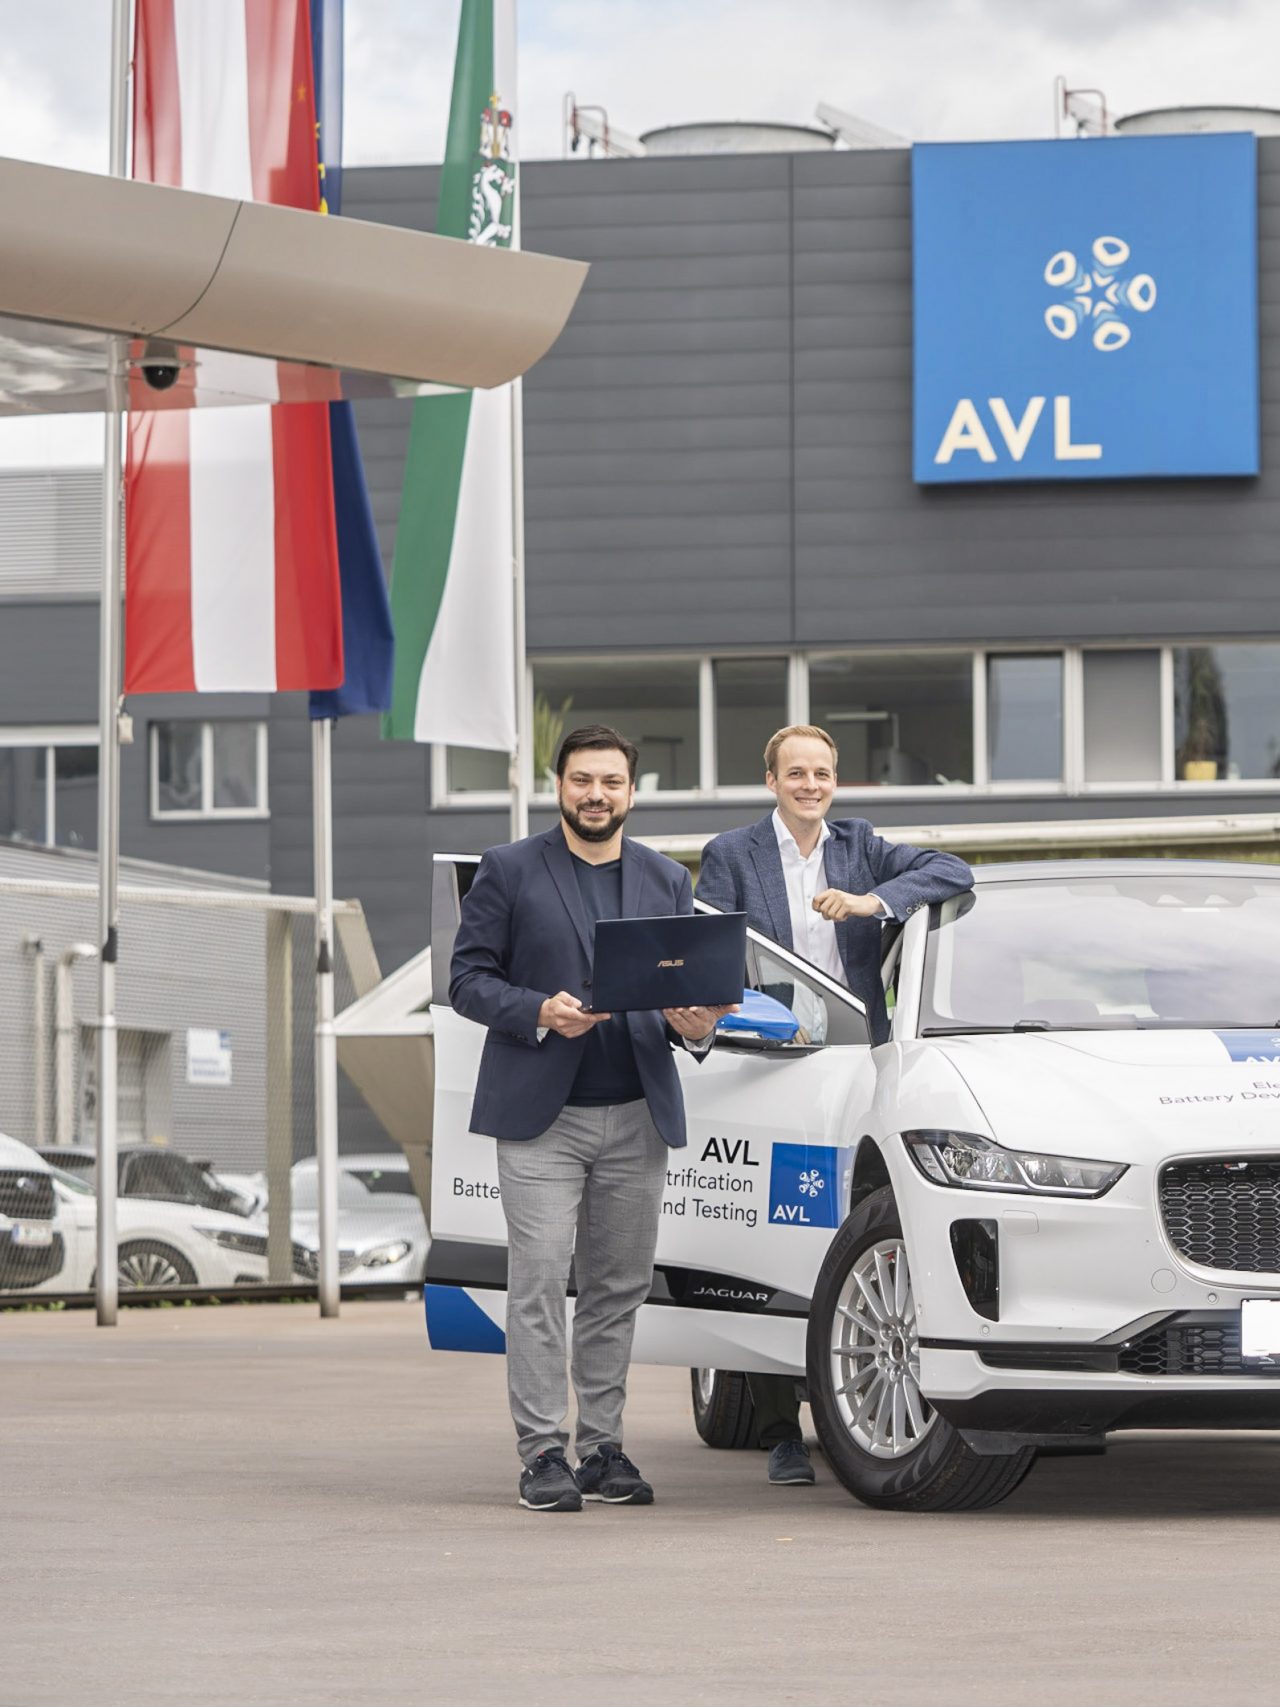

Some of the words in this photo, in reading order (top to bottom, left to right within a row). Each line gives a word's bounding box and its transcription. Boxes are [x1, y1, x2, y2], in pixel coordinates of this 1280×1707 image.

[934, 395, 1103, 464] AVL
[657, 959, 685, 968] ASUS
[1159, 1095, 1235, 1105] Battery
[700, 1137, 760, 1166] AVL
[666, 1167, 753, 1193] trification
[453, 1176, 501, 1199] Batte
[660, 1196, 686, 1216] nd
[692, 1198, 758, 1228] Testing
[773, 1204, 811, 1223] AVL
[693, 1287, 769, 1301] JAGUAR
